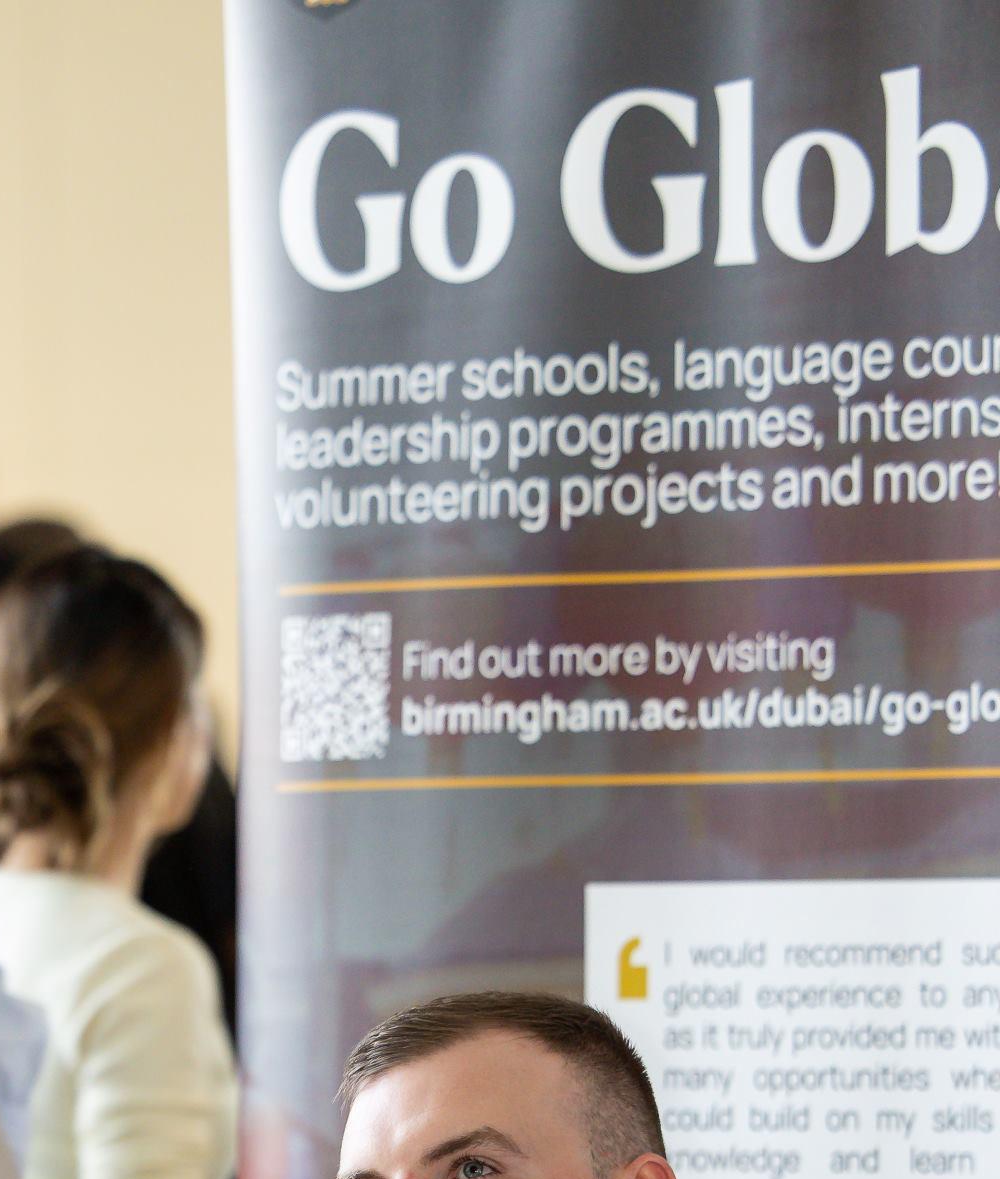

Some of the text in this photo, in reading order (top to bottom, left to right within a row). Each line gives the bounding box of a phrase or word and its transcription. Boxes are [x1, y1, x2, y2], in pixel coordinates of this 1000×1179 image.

[279, 66, 1000, 292] Go Glob
[276, 358, 454, 412] Summer
[462, 341, 659, 400] schools,
[674, 338, 893, 401] language
[277, 394, 1000, 472] leadership programmes, interns
[275, 455, 1000, 533] volunteering projects and more
[403, 634, 835, 683] Find out more by visiting
[402, 682, 1000, 743] birmingham.ac.uk/dubai/go-glo
[664, 942, 671, 966] I
[690, 942, 767, 967] would
[784, 941, 942, 967] recommend
[663, 981, 740, 1017] global
[756, 983, 902, 1013] experience
[919, 983, 947, 1009] to
[663, 1026, 694, 1050] as
[702, 1023, 718, 1049] it
[728, 1023, 784, 1055] truly
[792, 1023, 906, 1058] provided
[915, 1026, 955, 1050] me
[662, 1067, 733, 1096] many
[753, 1064, 930, 1096] opportunities
[663, 1103, 993, 1138] could build on my skills
[830, 1148, 879, 1173] and
[910, 1147, 975, 1173] learn
